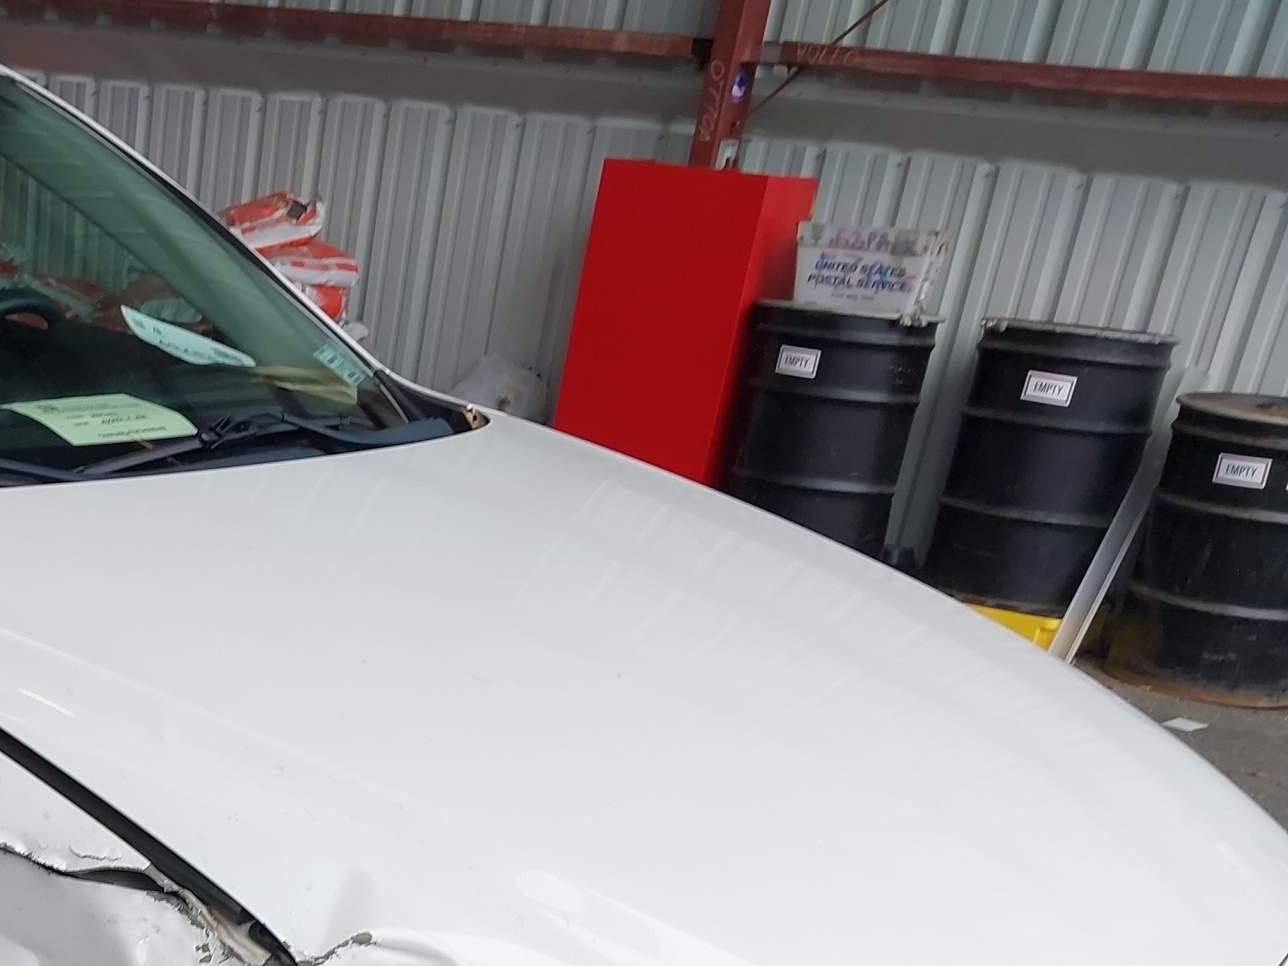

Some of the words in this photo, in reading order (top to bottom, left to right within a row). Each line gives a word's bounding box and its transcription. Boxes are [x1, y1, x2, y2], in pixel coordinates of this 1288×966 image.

[815, 260, 858, 273] UNITED
[861, 263, 907, 278] STATES
[807, 273, 853, 288] POSTAL
[783, 354, 811, 369] EMPTY
[1032, 381, 1065, 397] EMPTY
[1225, 463, 1258, 478] EMPTY
